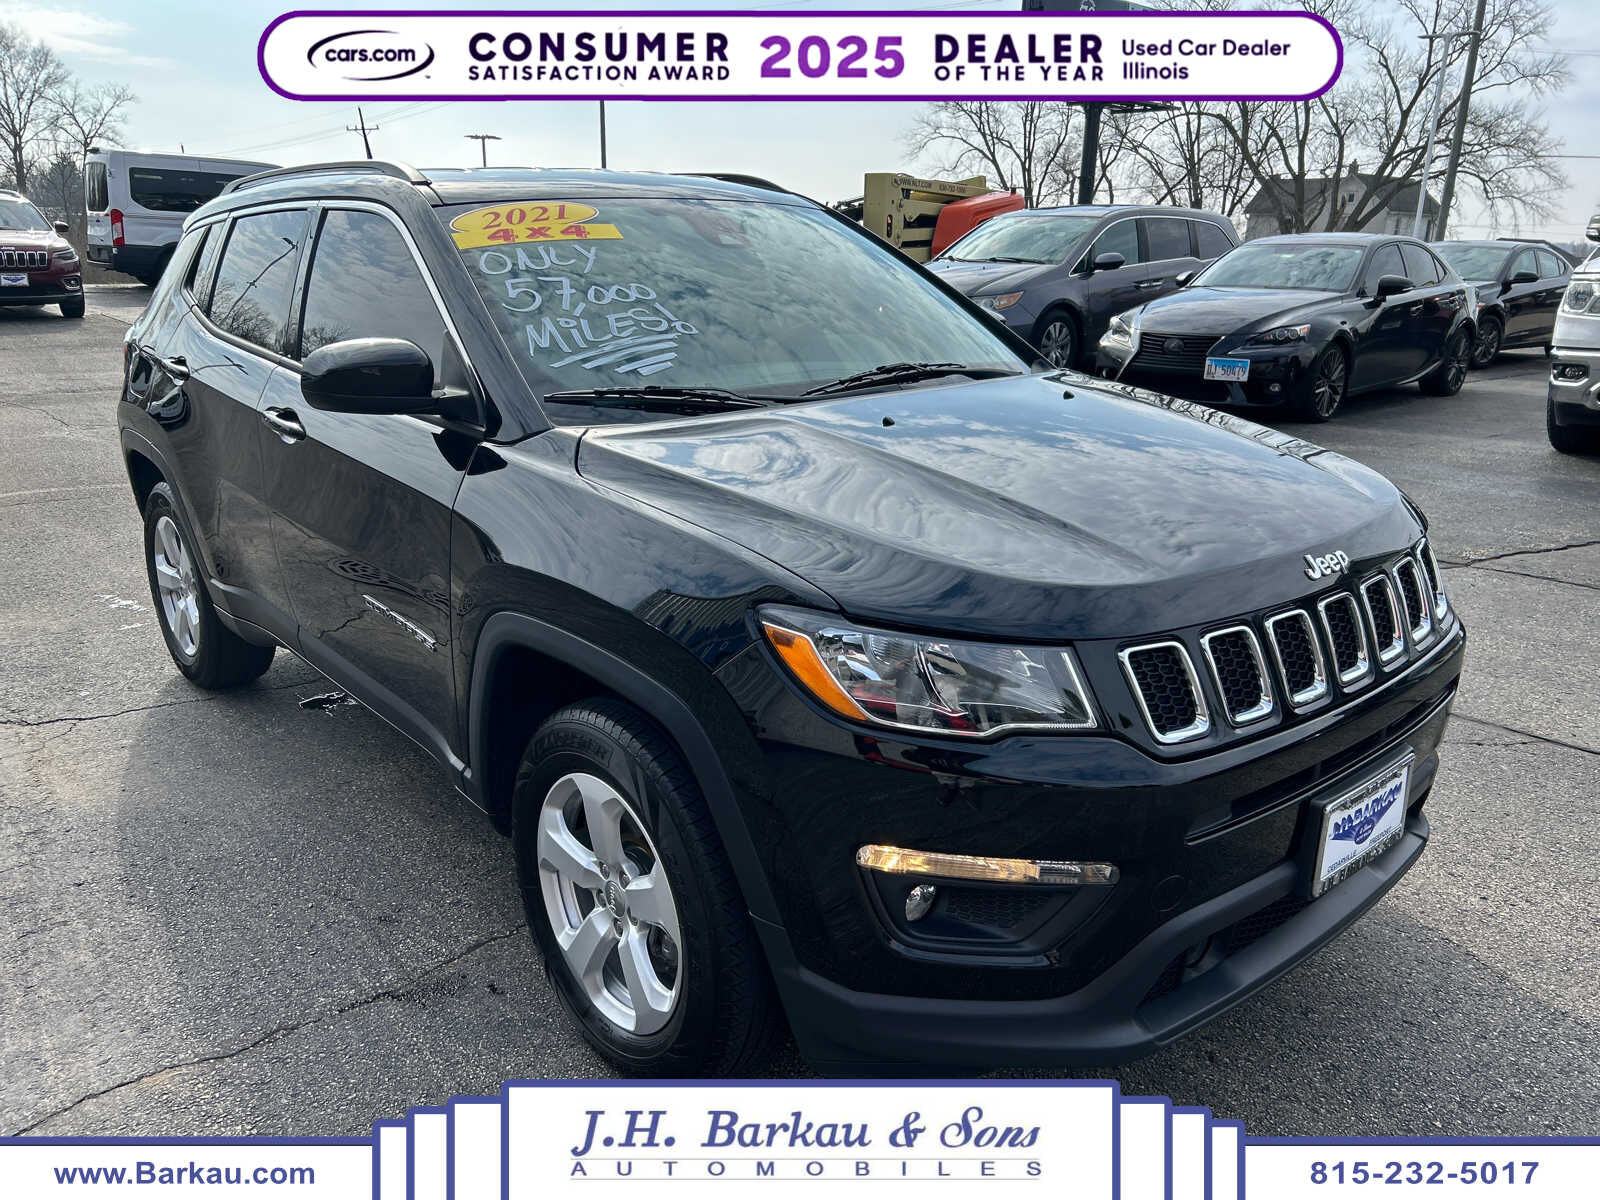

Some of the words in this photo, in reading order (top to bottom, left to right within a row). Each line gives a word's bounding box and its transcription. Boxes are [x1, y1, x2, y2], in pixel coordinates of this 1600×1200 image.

[482, 204, 568, 230] 2021
[479, 244, 597, 275] ONLY
[502, 276, 657, 317] 57,000
[1304, 550, 1349, 580] Jeep
